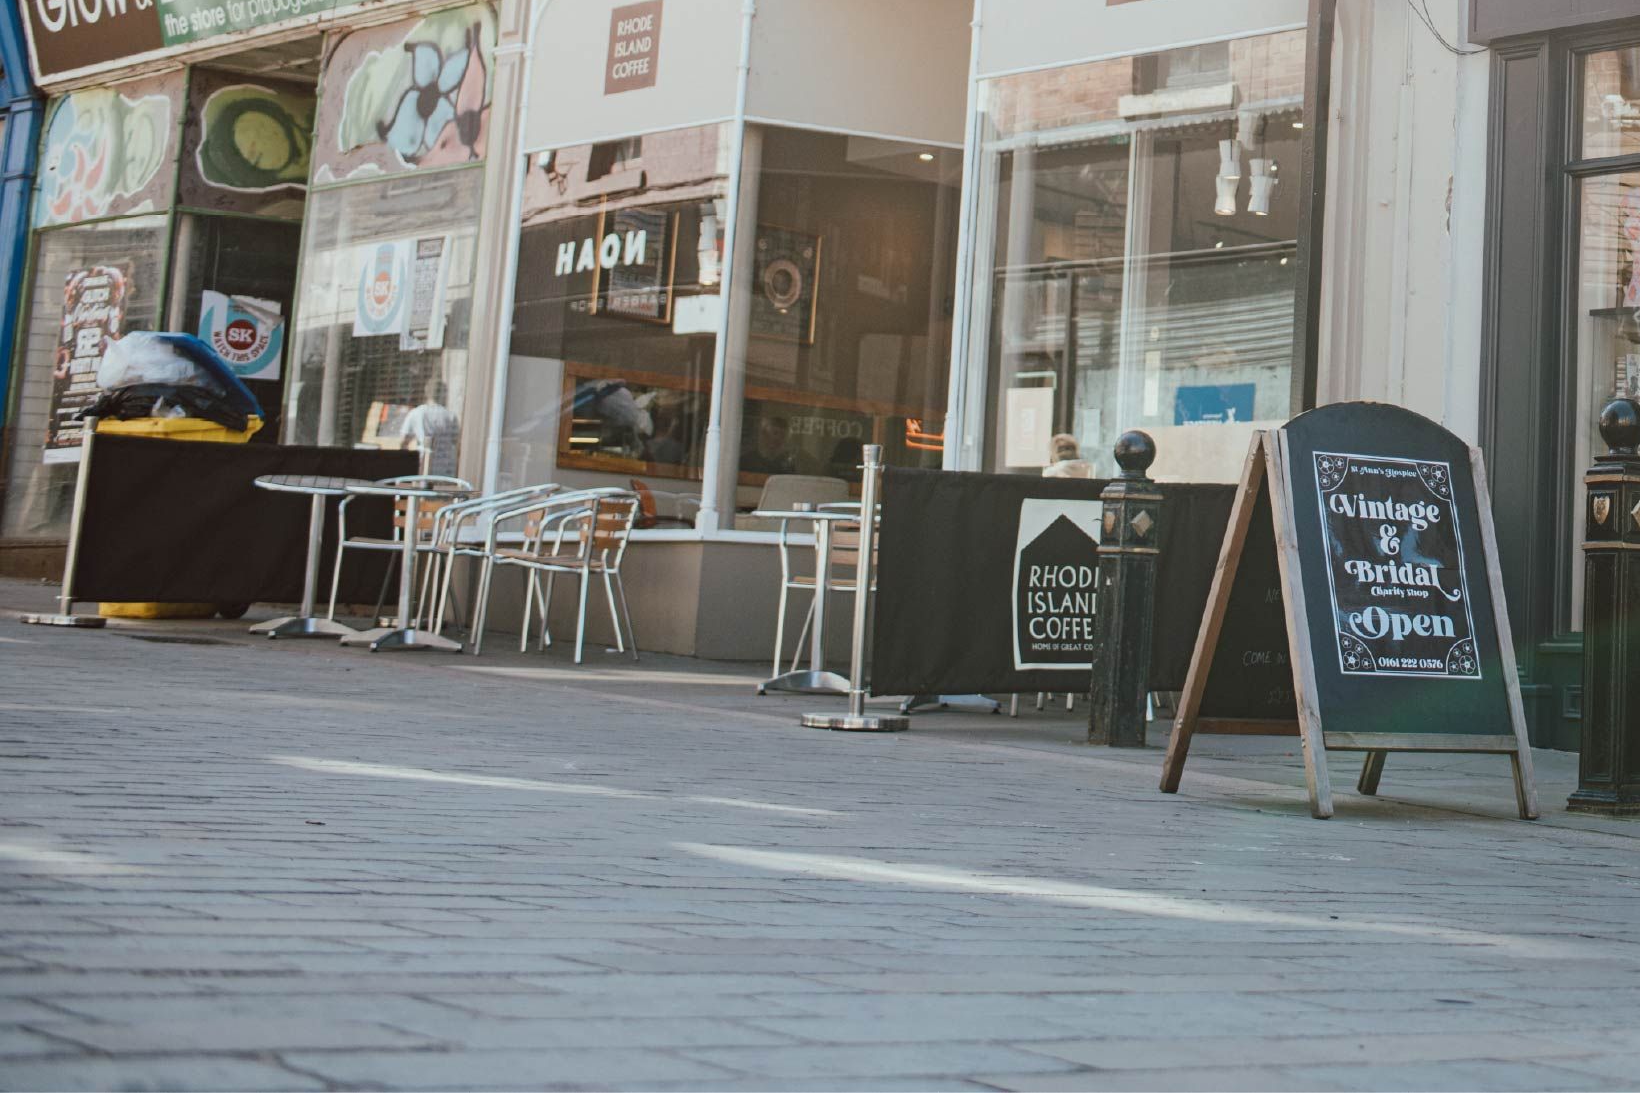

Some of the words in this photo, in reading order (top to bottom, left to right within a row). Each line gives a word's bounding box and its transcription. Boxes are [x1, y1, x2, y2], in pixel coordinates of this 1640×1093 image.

[164, 12, 189, 38] the
[191, 5, 226, 32] store
[227, 0, 247, 23] for
[617, 14, 654, 36] RHODE
[614, 36, 652, 58] ISLAND
[612, 57, 650, 80] COFFEE
[228, 327, 254, 343] SK
[231, 352, 250, 362] THIS
[1360, 466, 1384, 476] Ann's
[1385, 468, 1417, 478] Hospice
[1329, 493, 1441, 531] Vintage
[1379, 523, 1401, 555] &
[1344, 559, 1461, 601] Bridal
[1370, 585, 1405, 598] Charity
[1349, 606, 1456, 641] Open
[1060, 643, 1082, 651] GREAT
[1242, 650, 1272, 667] COME
[1378, 656, 1400, 668] 0161
[1400, 657, 1418, 668] 222
[1419, 658, 1444, 669] 0576
